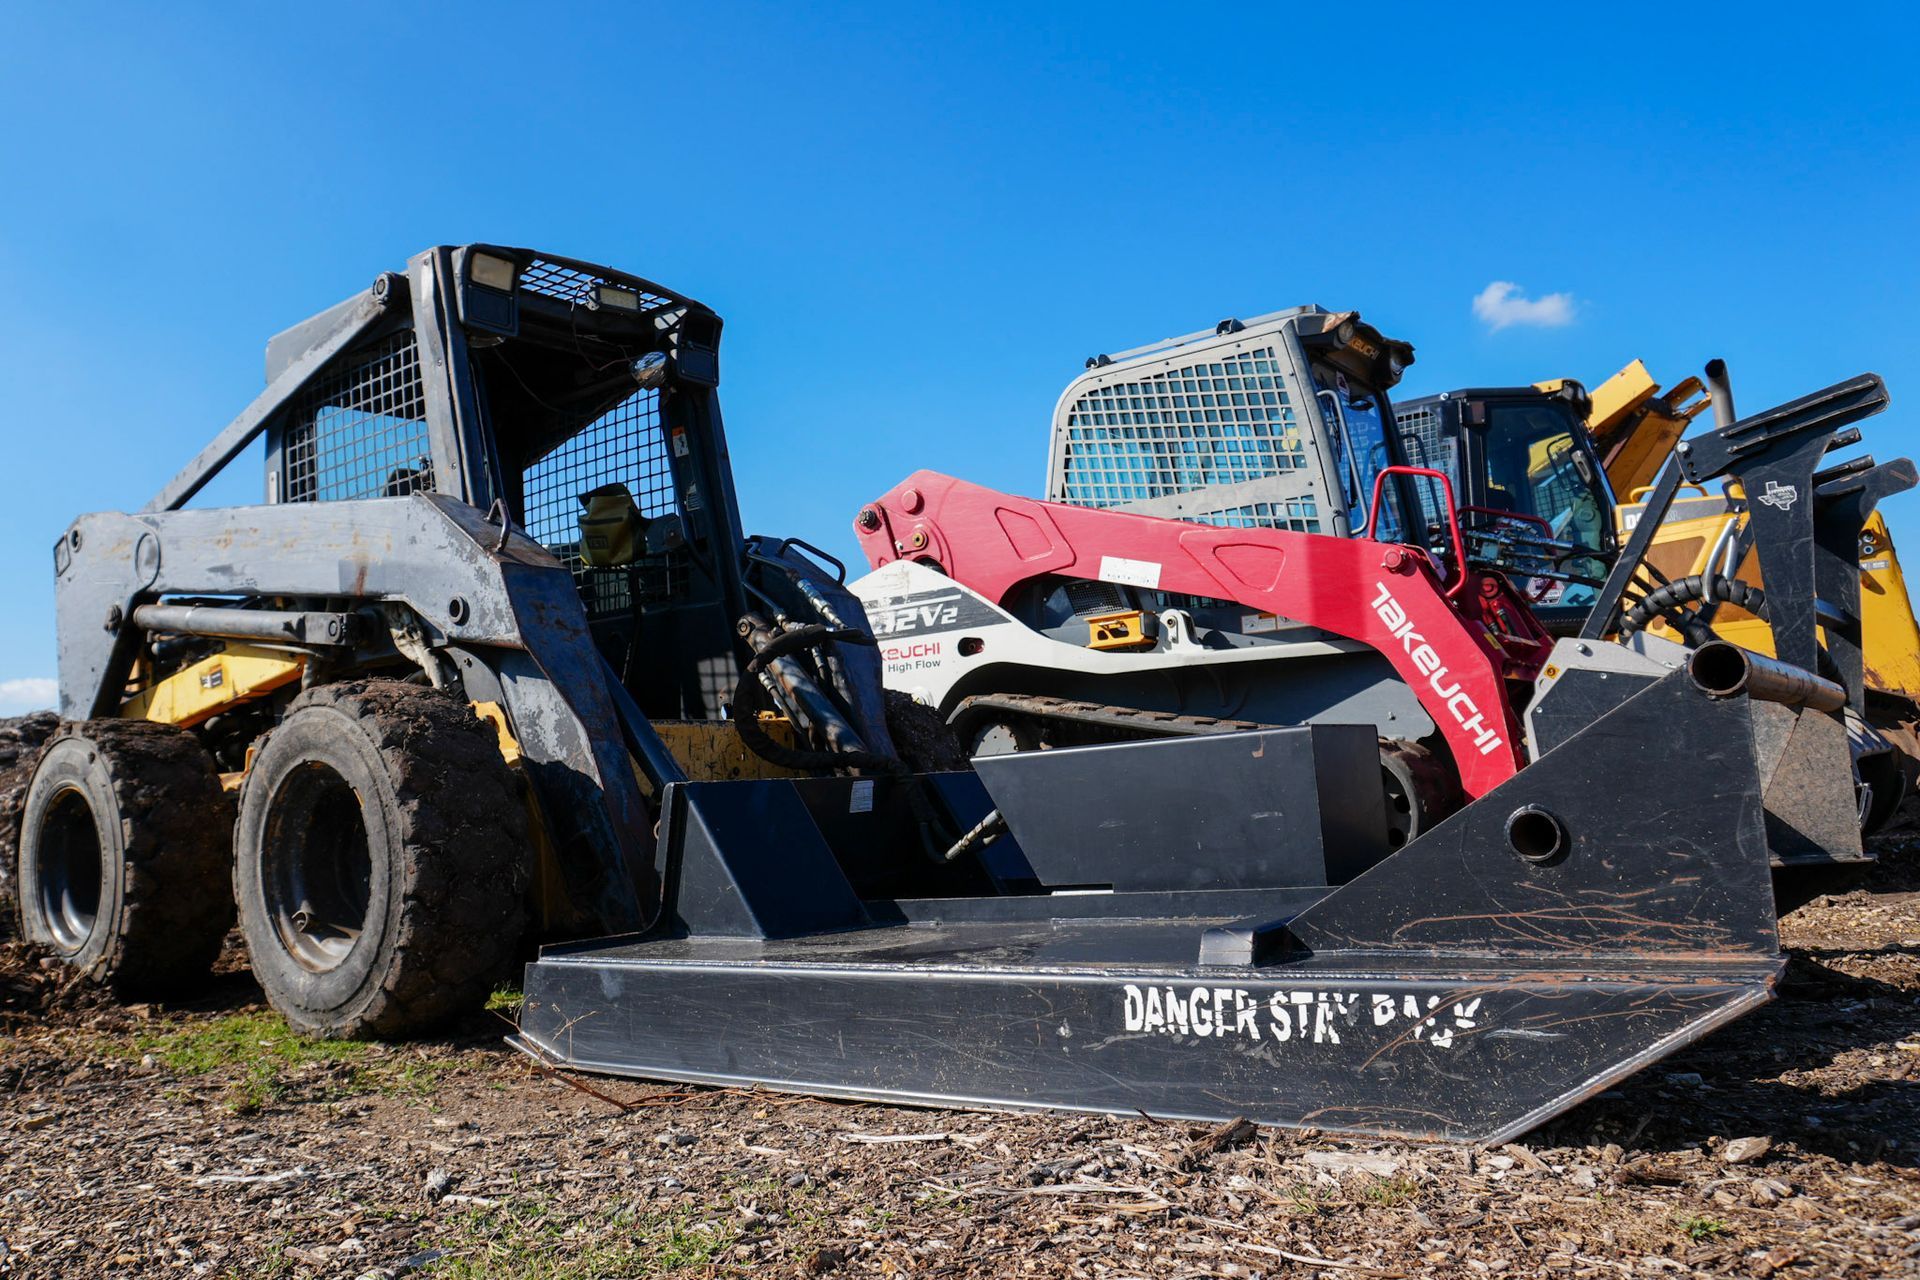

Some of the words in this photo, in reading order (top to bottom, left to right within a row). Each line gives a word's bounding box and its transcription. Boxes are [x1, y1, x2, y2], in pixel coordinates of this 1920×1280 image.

[888, 662, 912, 674] High
[915, 660, 941, 670] Flow
[1123, 984, 1261, 1040] DANGER
